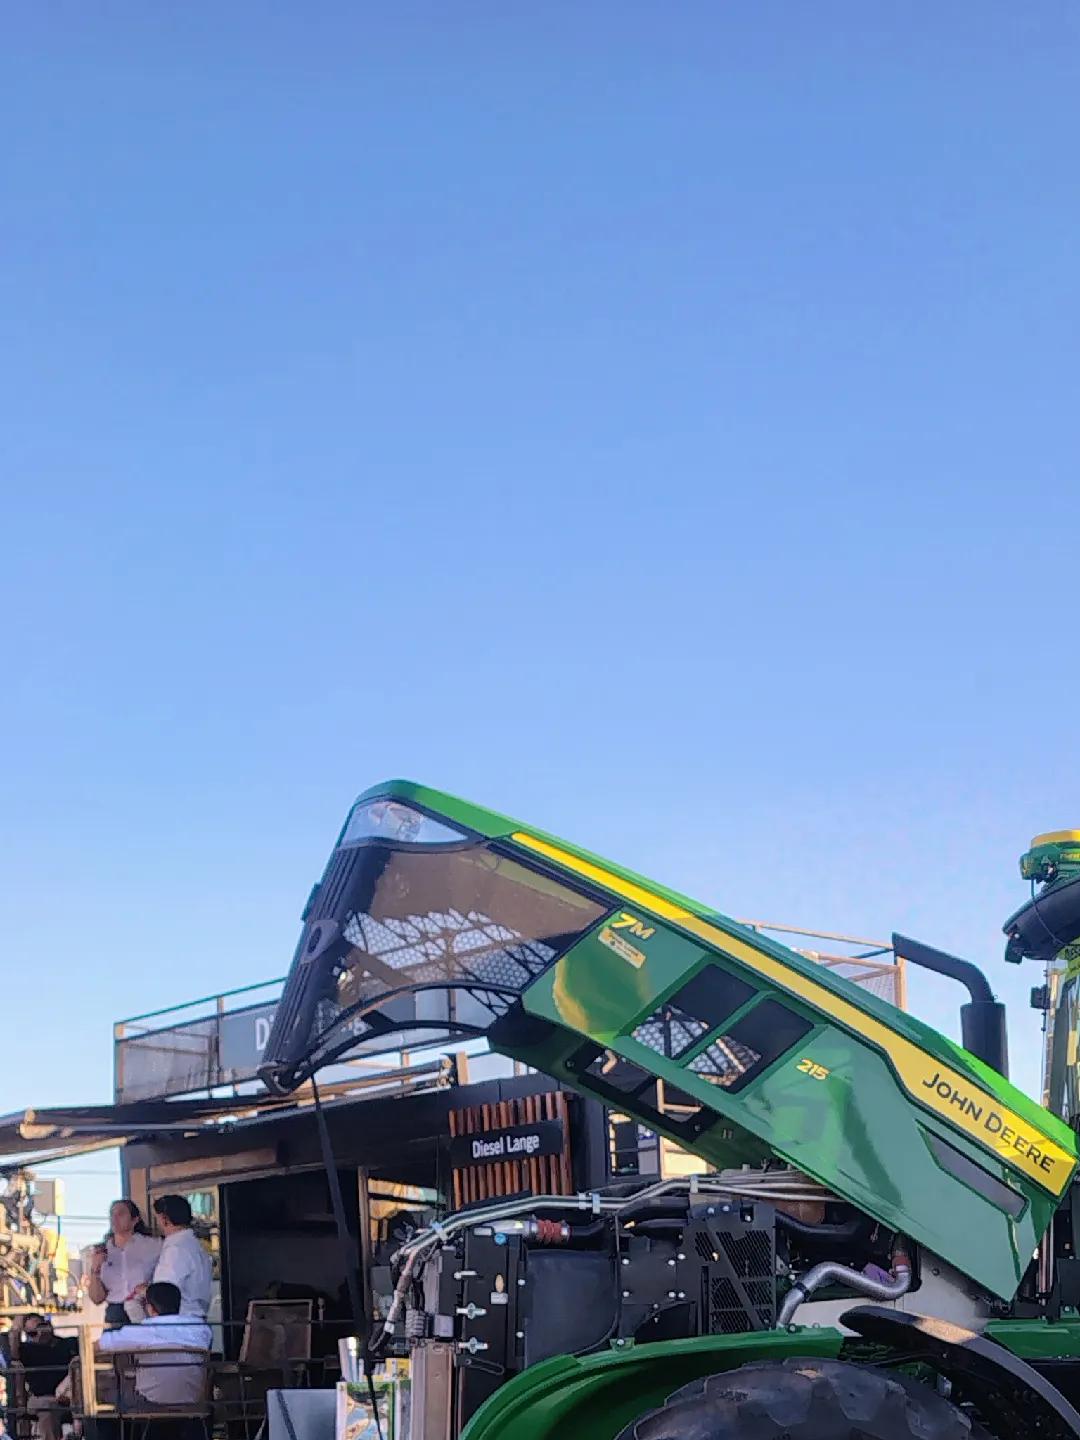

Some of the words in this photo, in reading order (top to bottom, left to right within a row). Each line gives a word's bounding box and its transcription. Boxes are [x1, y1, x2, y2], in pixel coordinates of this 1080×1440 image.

[611, 911, 656, 940] 7M
[796, 1058, 830, 1080] 215
[922, 1073, 983, 1121] JOHN
[984, 1111, 1056, 1174] DEERE
[472, 1136, 504, 1158] Diesel
[506, 1134, 540, 1153] Lange
